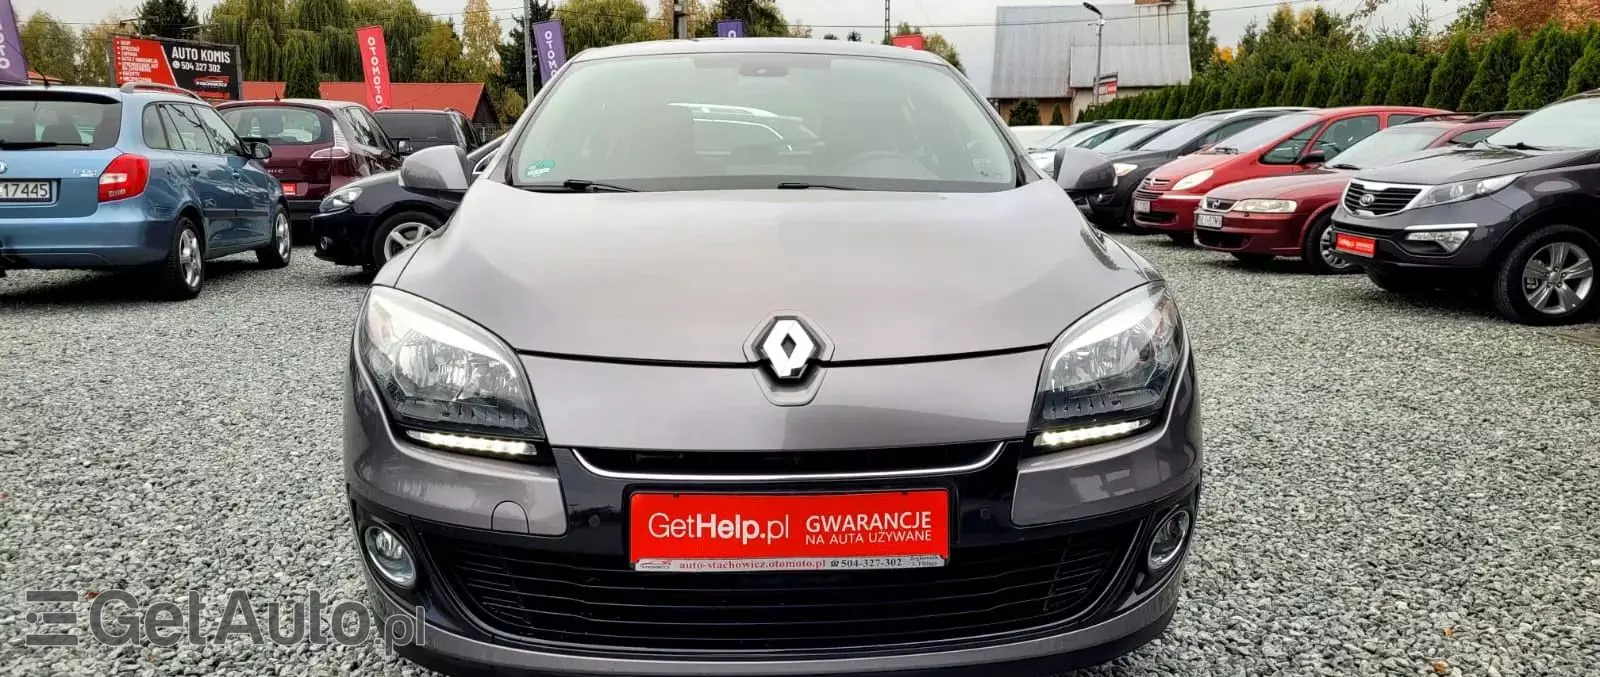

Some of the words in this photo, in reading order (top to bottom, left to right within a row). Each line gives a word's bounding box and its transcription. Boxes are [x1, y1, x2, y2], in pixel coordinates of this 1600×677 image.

[171, 46, 198, 61] AUTO
[200, 49, 231, 64] KOMIS
[181, 61, 194, 70] 504
[195, 62, 207, 72] 327
[208, 63, 221, 73] 302
[367, 36, 384, 105] OTOMOTO
[0, 183, 49, 198] 17445
[648, 512, 789, 545] GetHelp.pl
[805, 511, 932, 533] GWARANCJE
[805, 534, 825, 545] NA
[829, 532, 864, 545] AUTA
[868, 529, 932, 543] UŻYWANE
[679, 558, 827, 570] auto-stachowicz.otomoto.pl
[841, 557, 903, 568] 504-327-302
